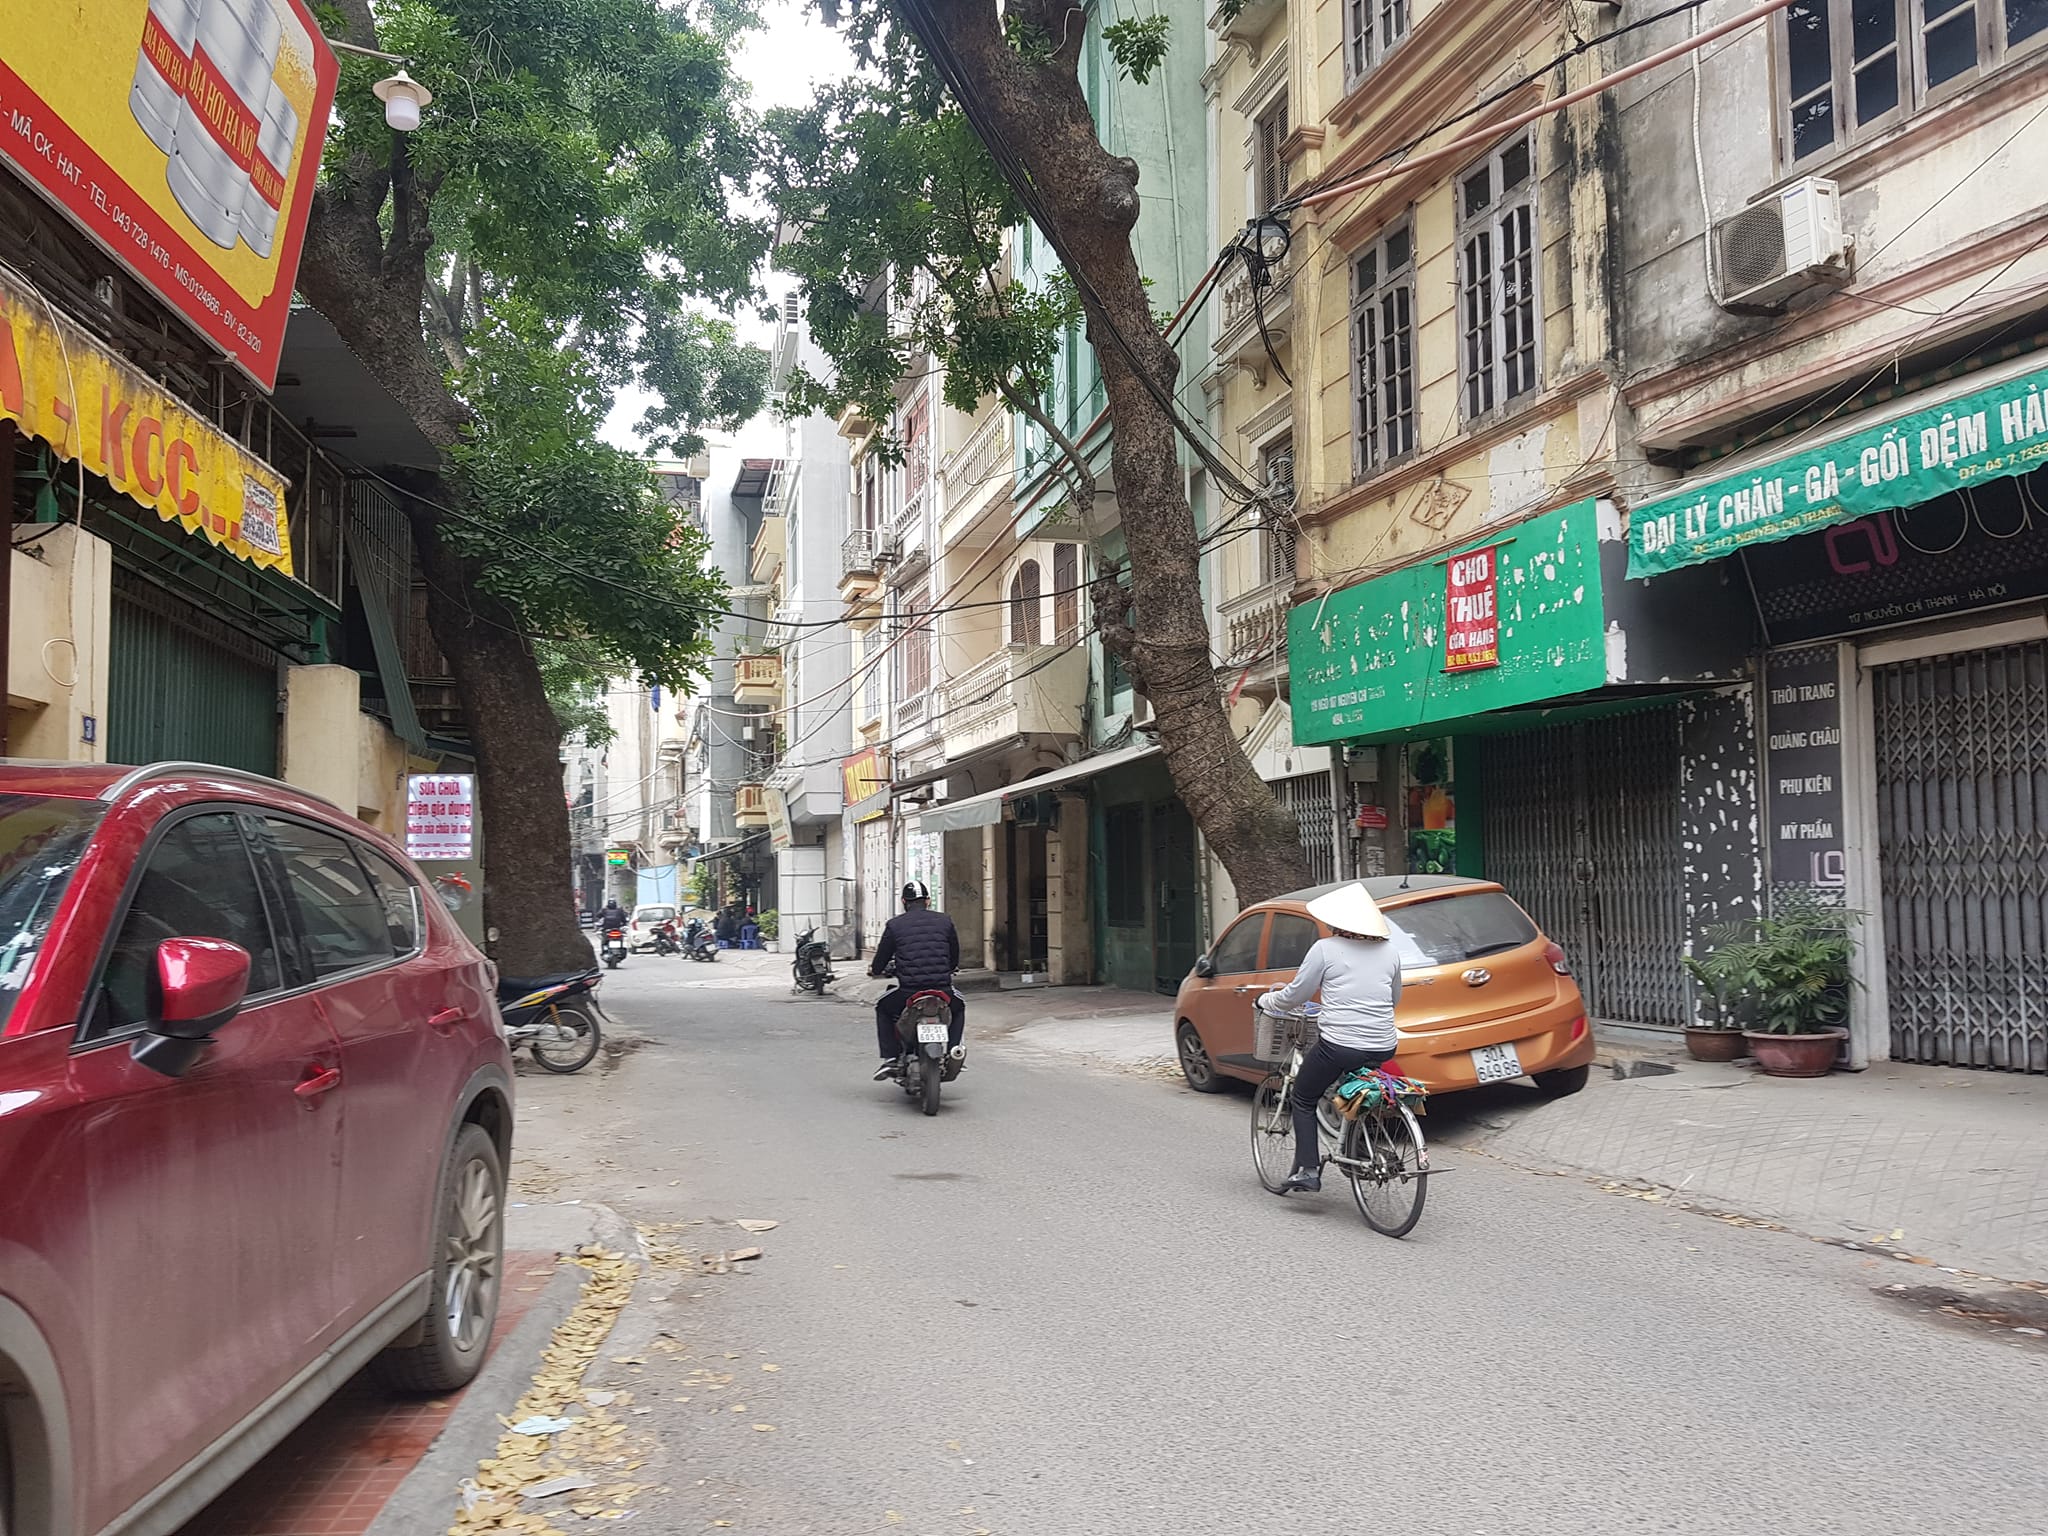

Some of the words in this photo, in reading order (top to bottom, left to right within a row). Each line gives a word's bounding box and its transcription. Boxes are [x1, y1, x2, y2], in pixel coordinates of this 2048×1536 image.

[144, 21, 157, 54] BIA
[189, 58, 207, 105] BIA
[222, 104, 240, 148] HÀ
[237, 121, 257, 166] NỘI
[34, 132, 55, 163] CK:
[57, 152, 82, 186] HAT
[90, 181, 111, 216] TEL:
[112, 206, 130, 232] 043
[132, 222, 148, 248] 728
[150, 241, 170, 269] 1476
[1643, 513, 1675, 554] ĐẠI
[1685, 495, 1709, 540] LÝ
[1719, 477, 1784, 530] CHĂN
[1805, 461, 1839, 504] GA
[1860, 427, 1910, 487] GỐI
[1920, 413, 1988, 470] ĐỆM
[1452, 554, 1488, 587] CHO
[1451, 585, 1493, 623] THUÊ
[1925, 594, 1957, 609] THANH
[1968, 588, 1984, 601] HÀ
[1798, 682, 1835, 701] TRANG
[1810, 726, 1840, 746] CHÂU
[1780, 779, 1803, 796] PHỤ
[1804, 774, 1832, 795] KIỆN
[1781, 821, 1798, 839] MỸ
[1800, 818, 1833, 839] PHẨM
[1481, 1046, 1507, 1063] 30A
